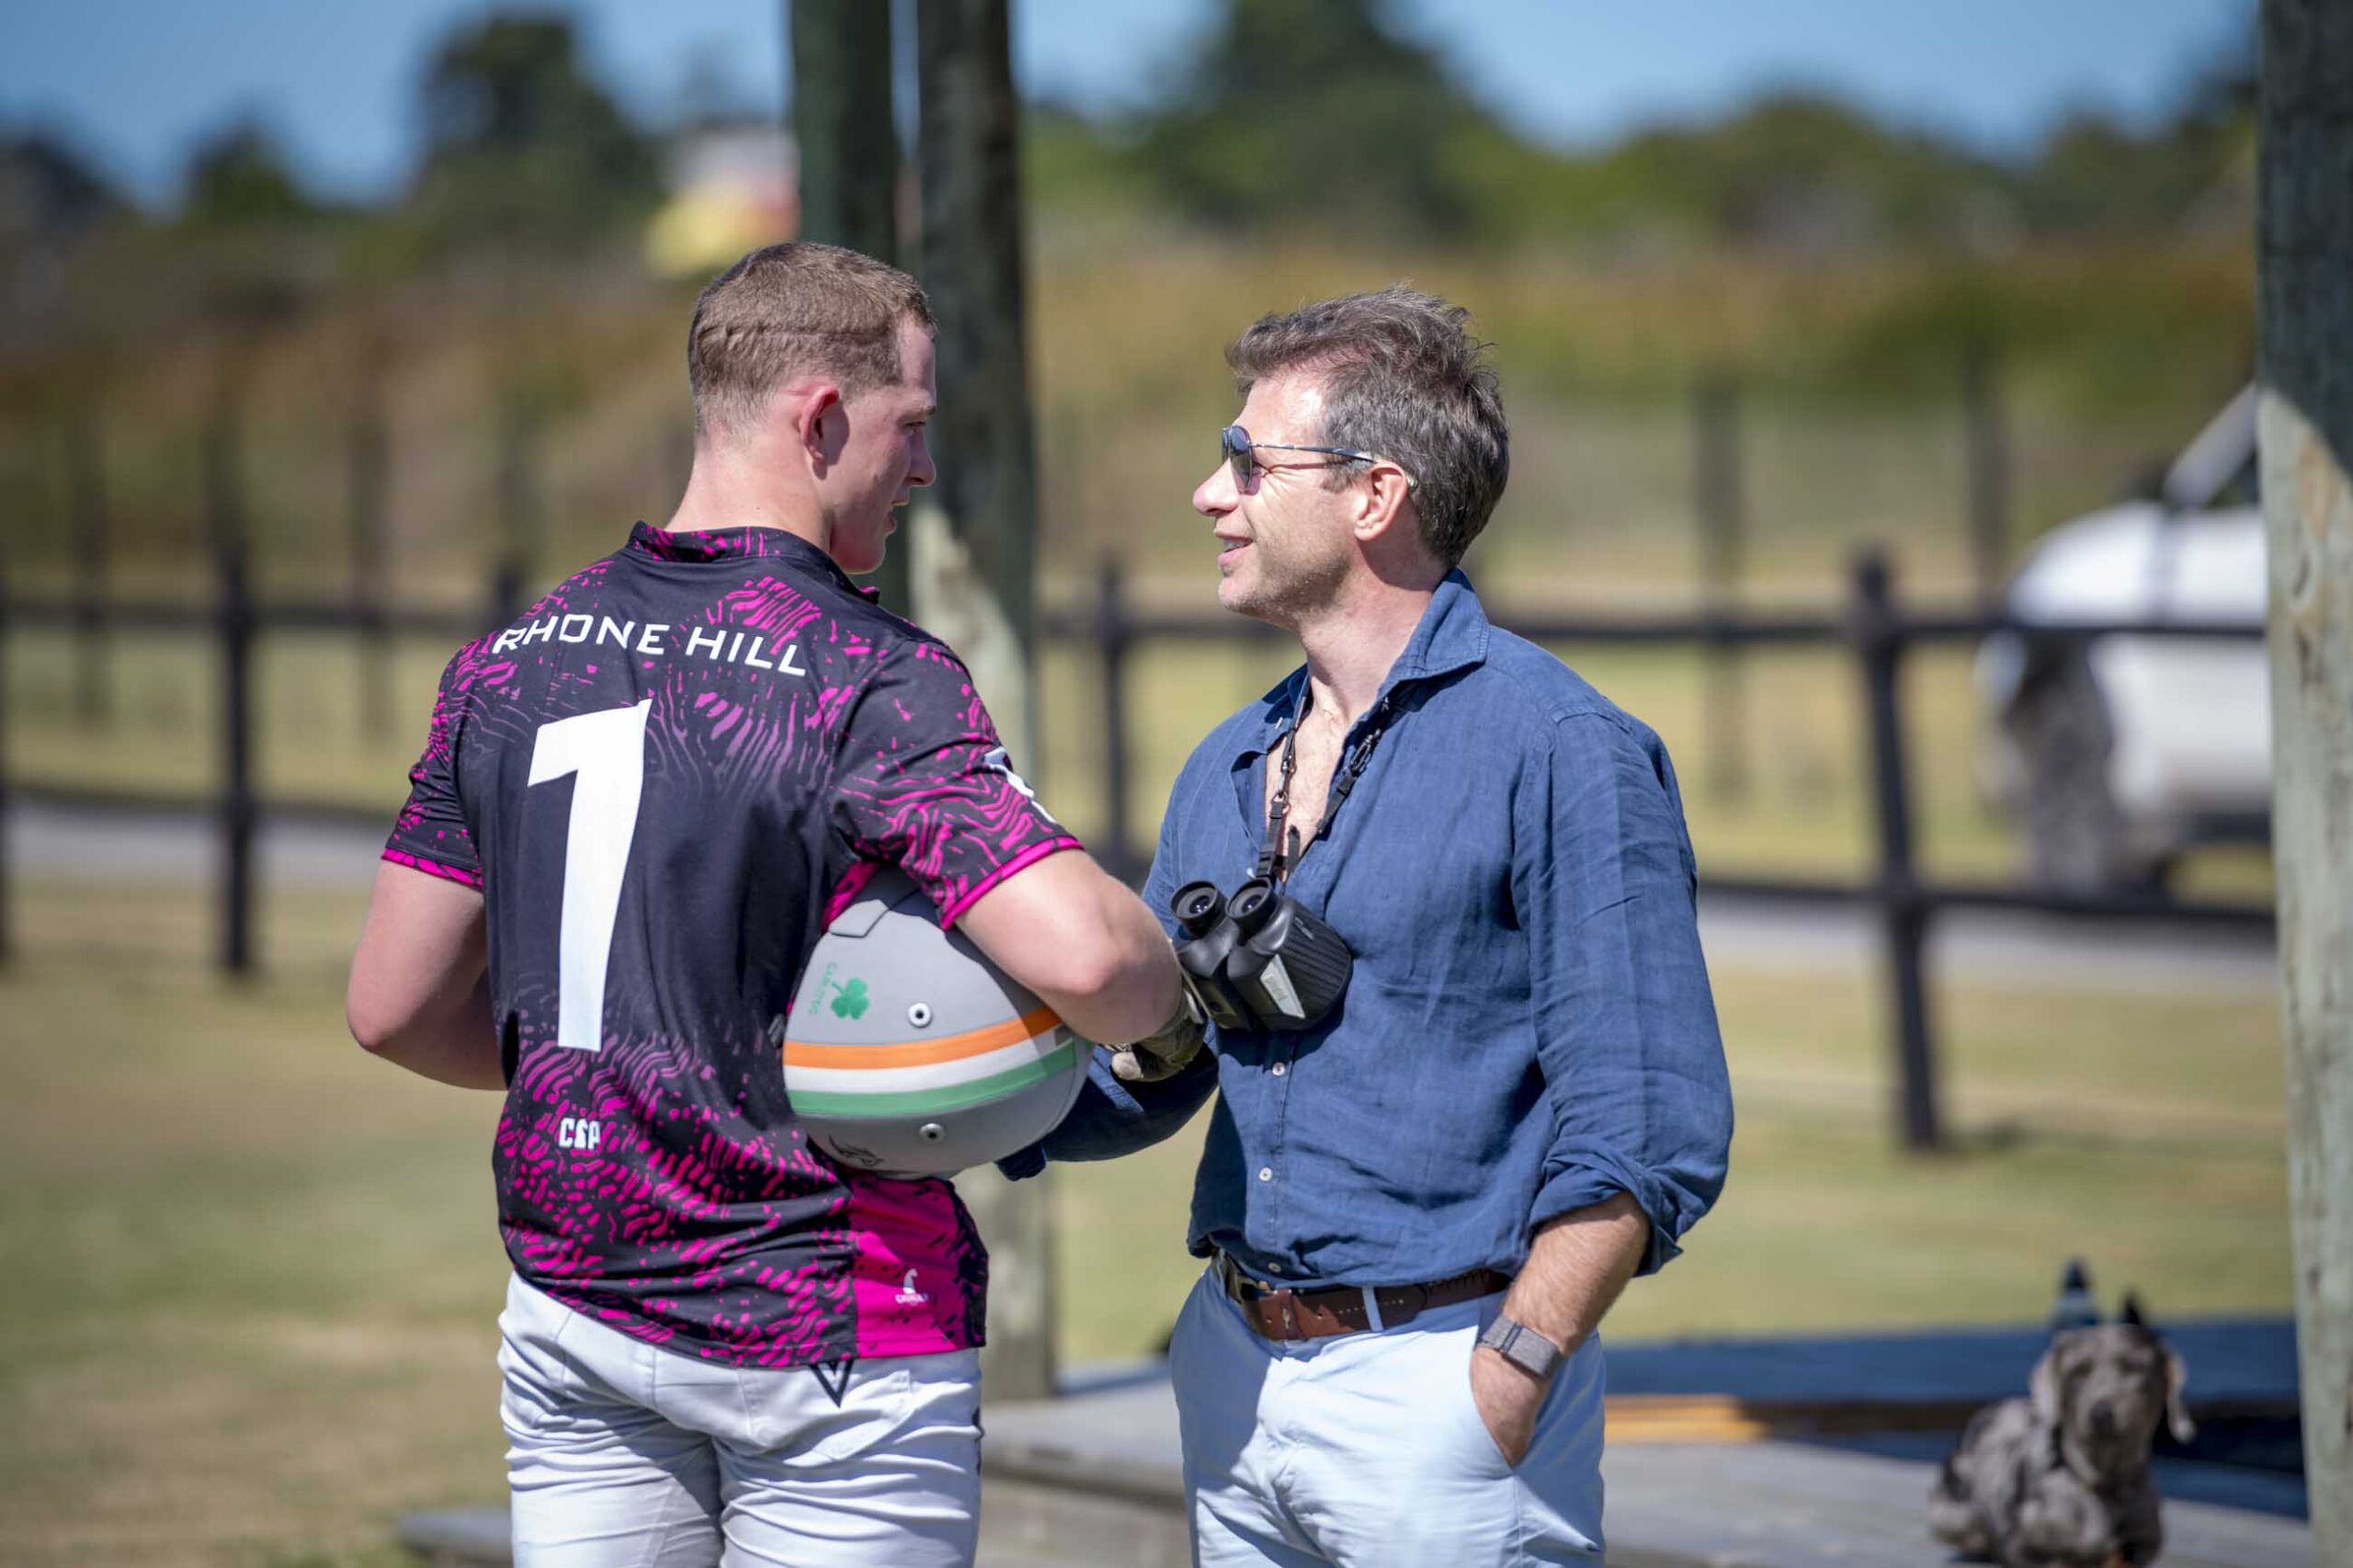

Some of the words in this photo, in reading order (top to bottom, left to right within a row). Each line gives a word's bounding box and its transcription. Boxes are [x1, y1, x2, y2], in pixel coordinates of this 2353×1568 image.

[492, 613, 669, 654] RHONE
[685, 626, 806, 676] HILL
[528, 699, 653, 1051] 1
